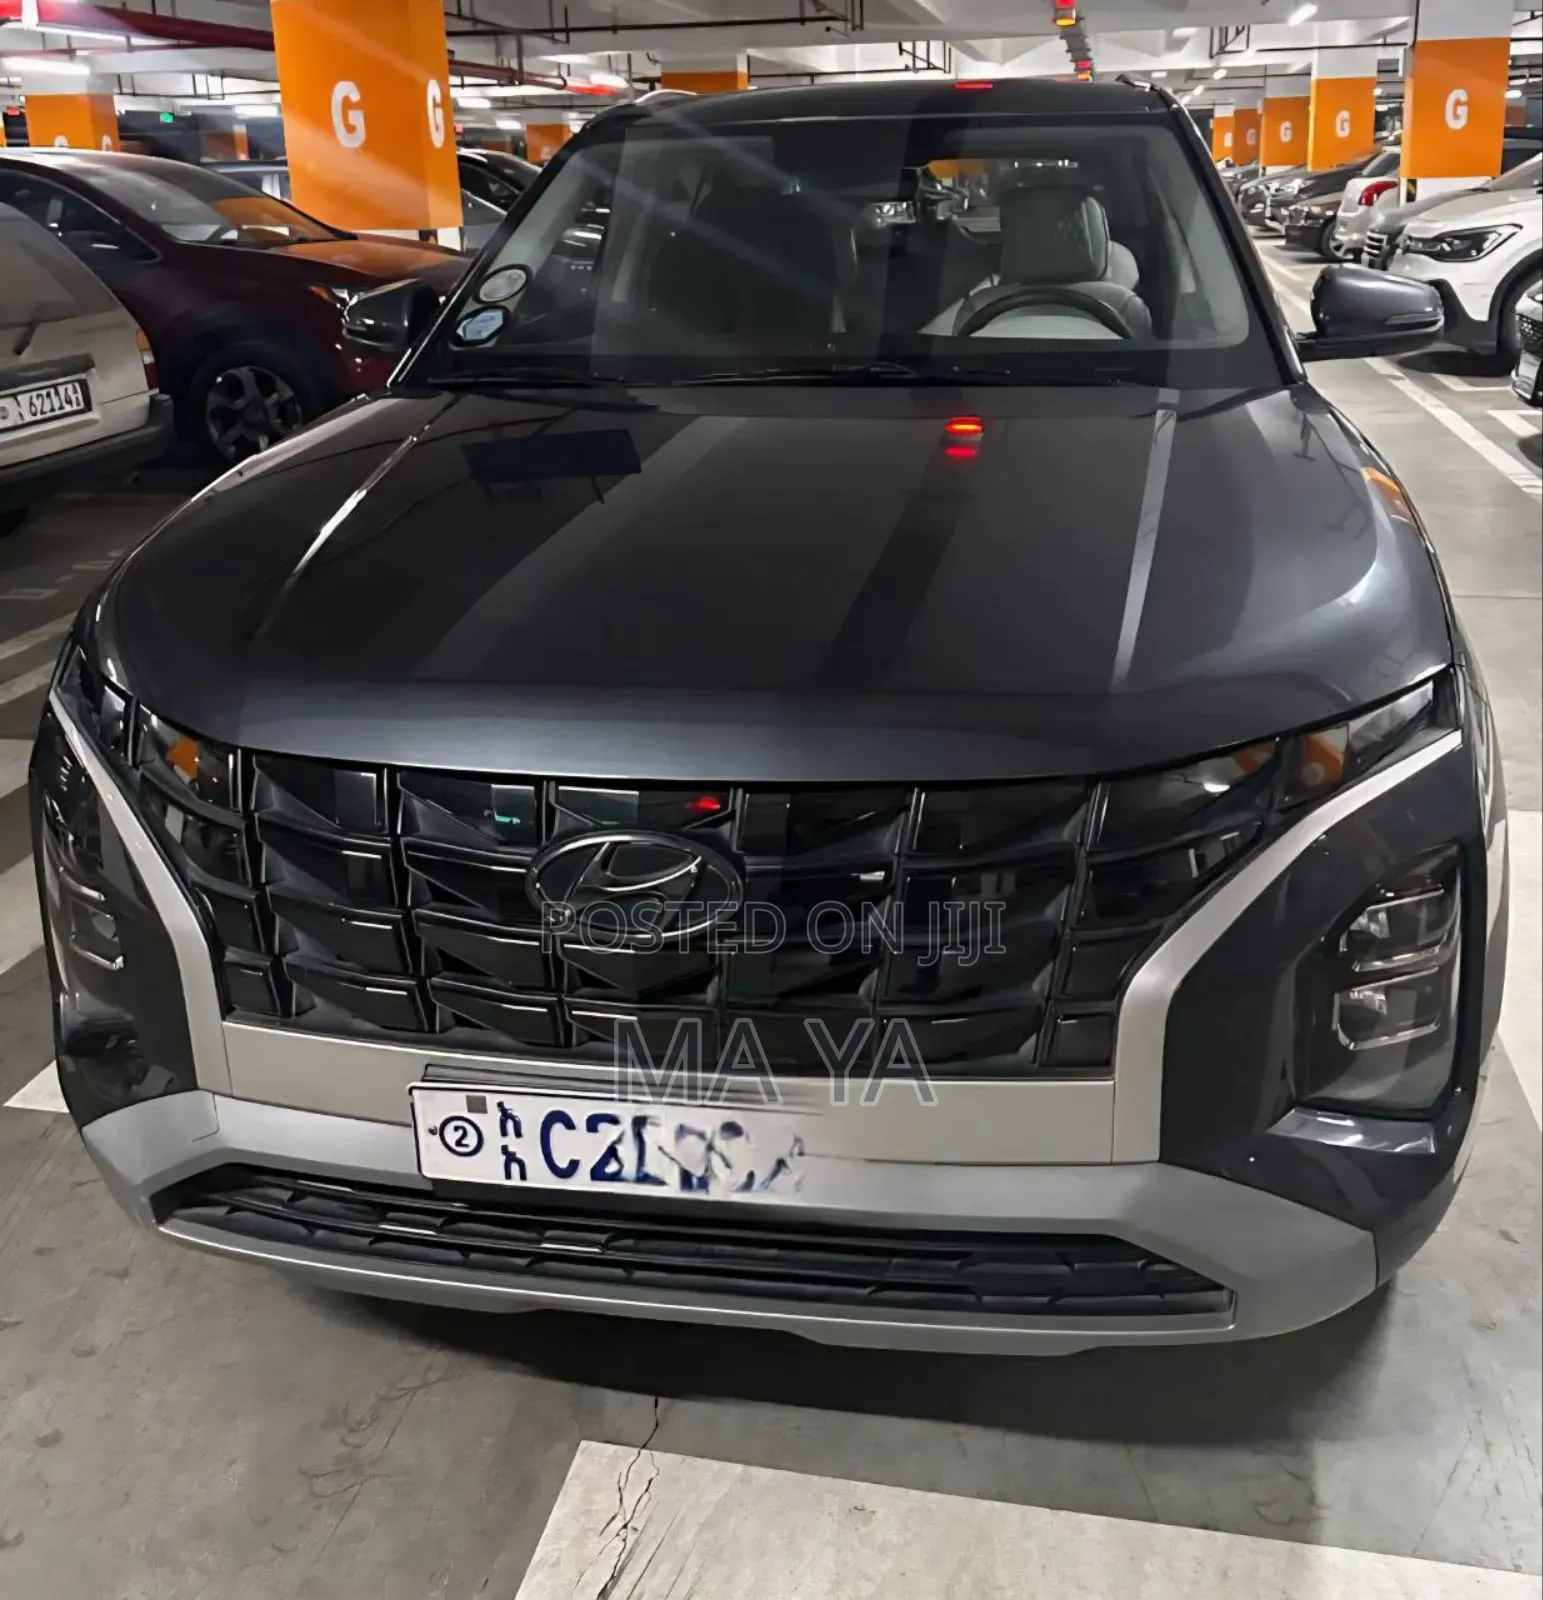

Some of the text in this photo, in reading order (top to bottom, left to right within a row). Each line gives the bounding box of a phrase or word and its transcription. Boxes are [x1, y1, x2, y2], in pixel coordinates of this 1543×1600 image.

[331, 80, 366, 149] G
[426, 79, 445, 149] G
[1335, 110, 1351, 138] G
[1445, 88, 1469, 130] G
[453, 1125, 470, 1148] 2
